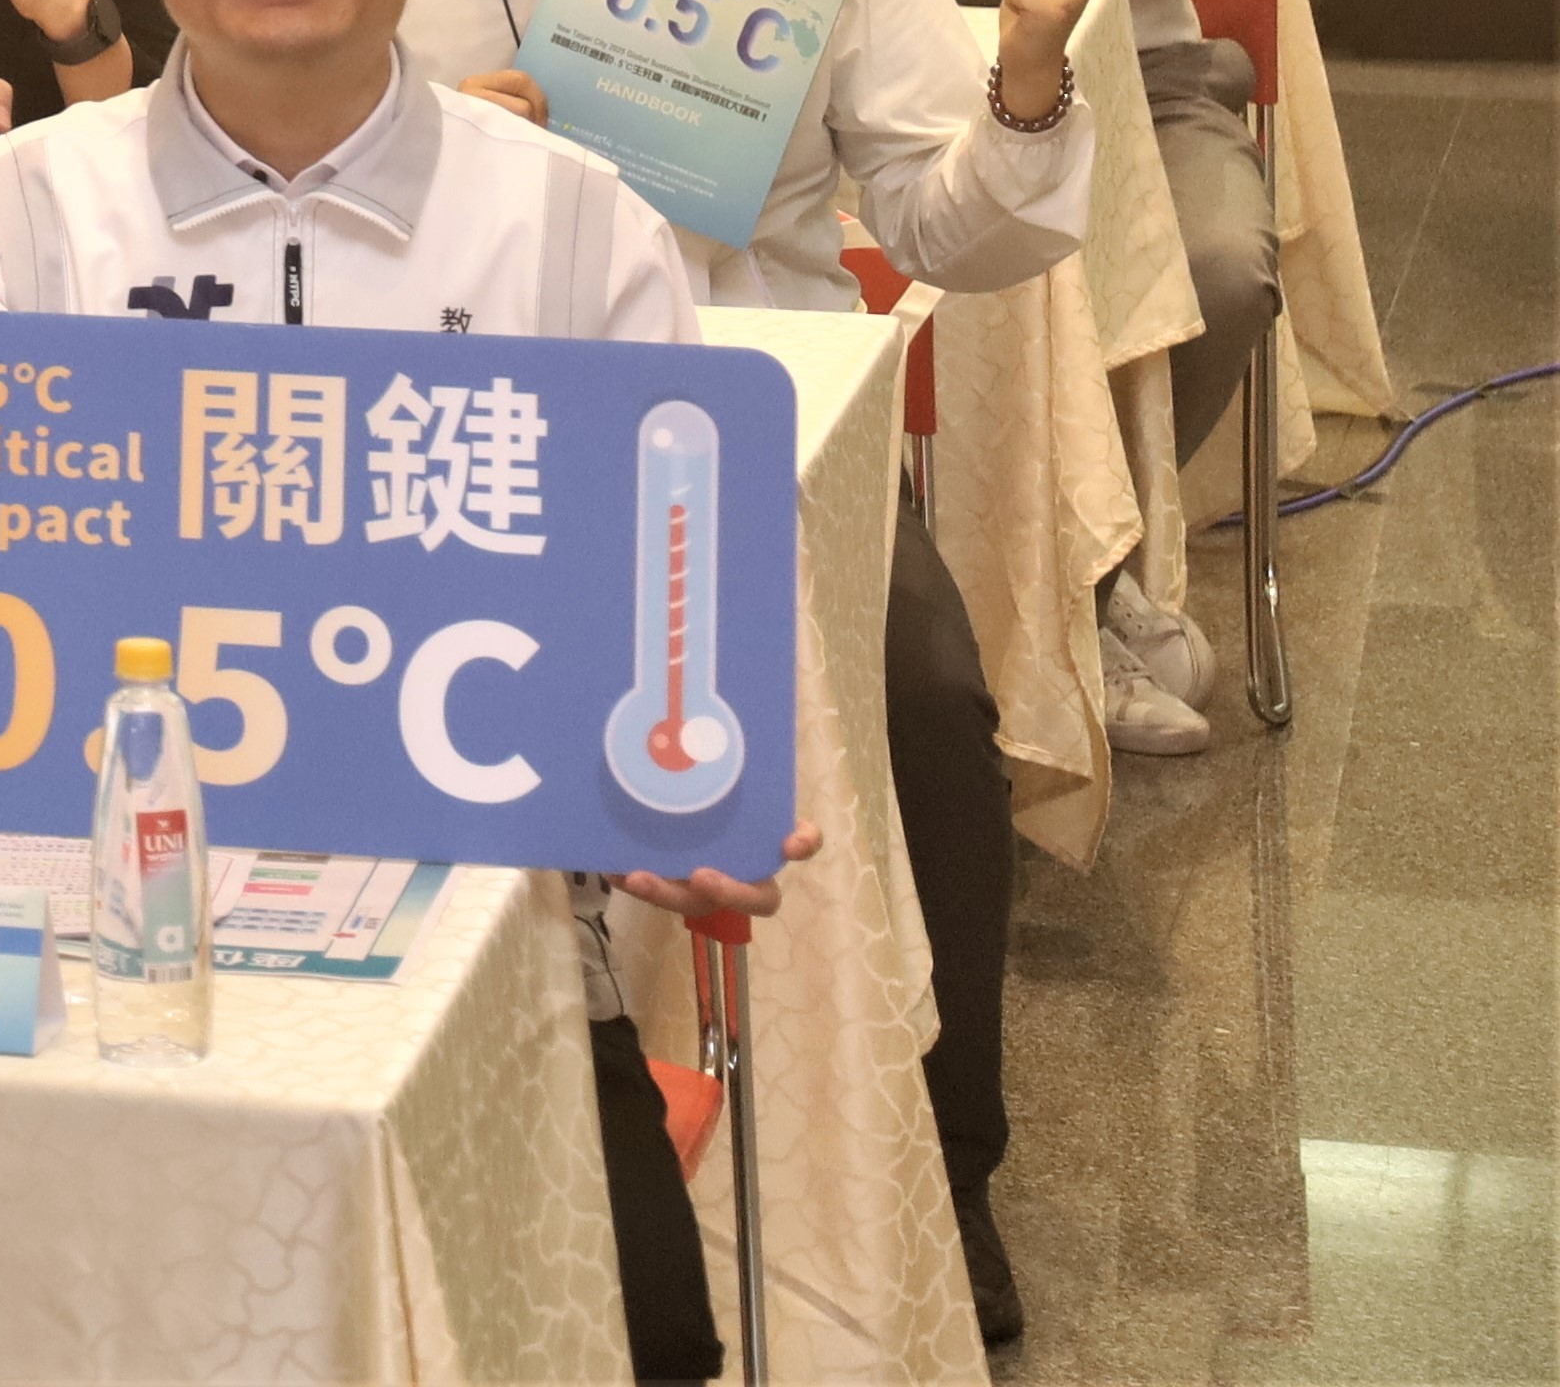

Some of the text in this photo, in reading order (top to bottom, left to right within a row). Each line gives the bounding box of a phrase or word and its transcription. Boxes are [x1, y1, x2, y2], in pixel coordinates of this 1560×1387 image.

[596, 77, 702, 126] HANDBOOK
[439, 306, 473, 334] 教
[177, 366, 549, 556] 關鍵
[143, 833, 187, 853] UNI
